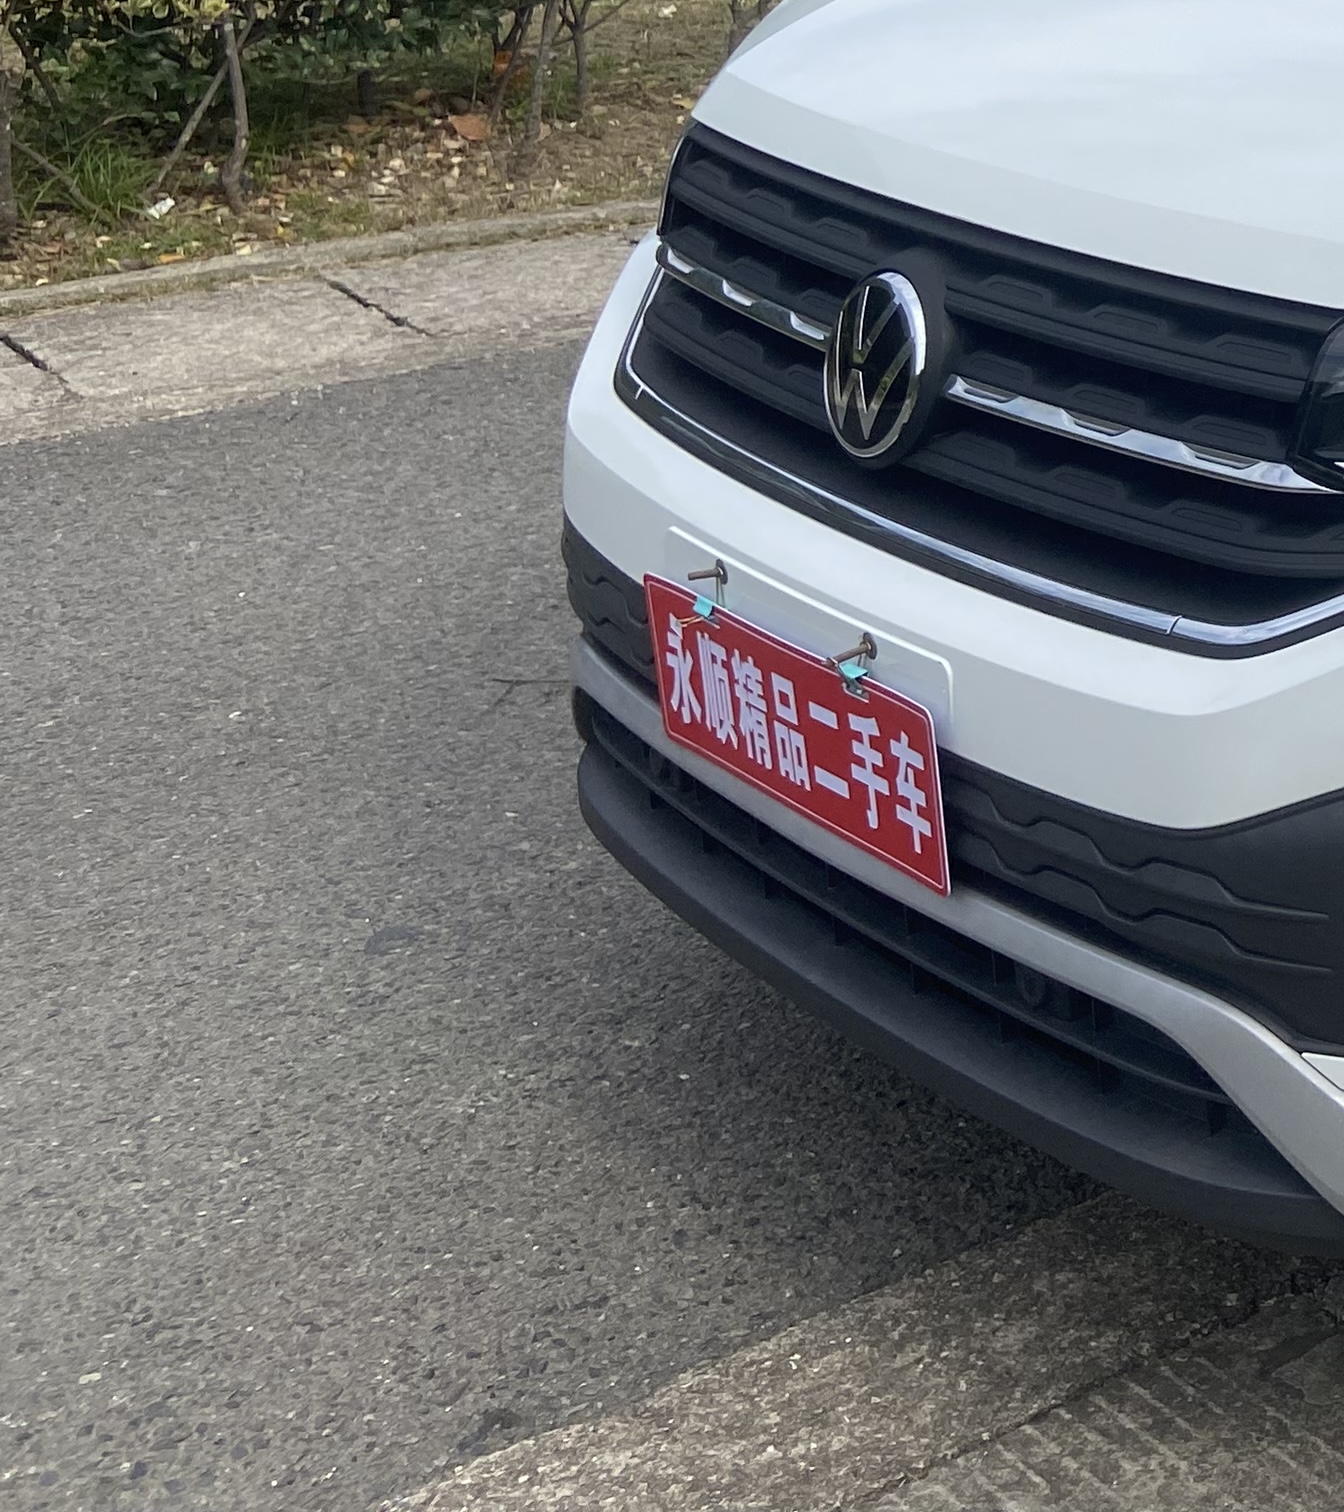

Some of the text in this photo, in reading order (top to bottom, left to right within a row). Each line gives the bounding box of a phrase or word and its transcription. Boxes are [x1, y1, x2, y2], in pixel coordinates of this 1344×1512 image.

[666, 613, 932, 855] 永顺精品二手车
